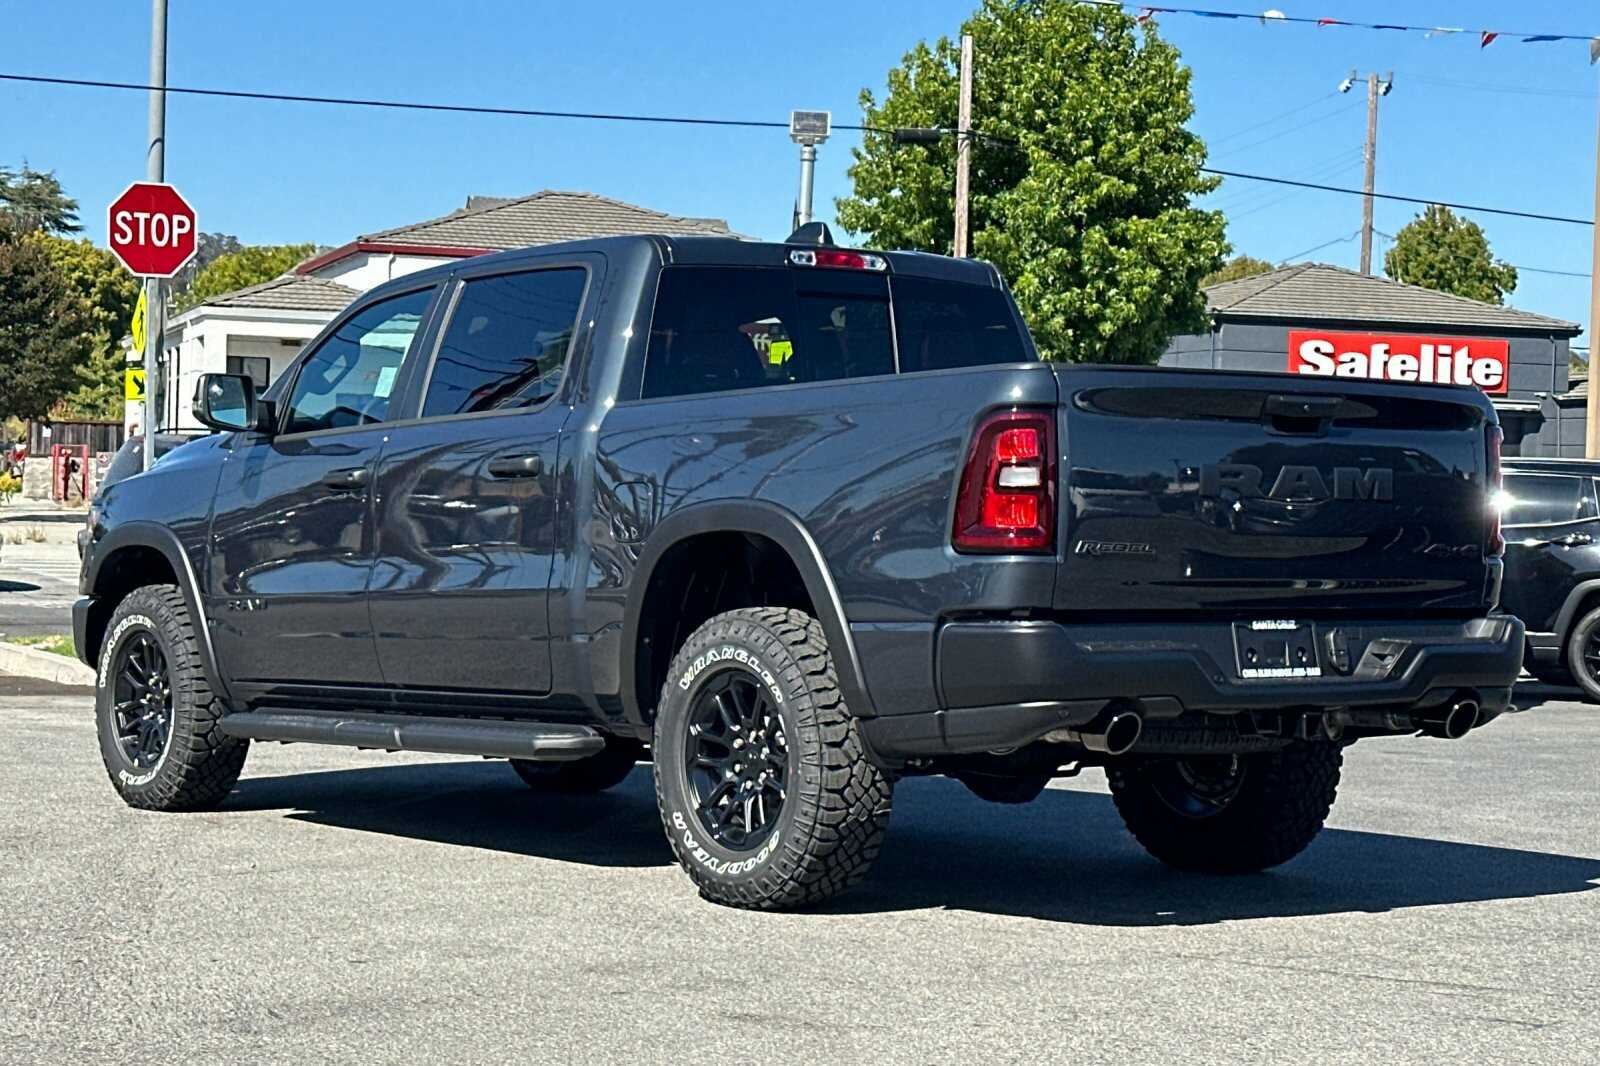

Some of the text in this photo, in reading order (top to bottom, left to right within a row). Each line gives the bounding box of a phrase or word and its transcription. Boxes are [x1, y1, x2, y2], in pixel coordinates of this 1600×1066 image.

[114, 210, 191, 248] STOP
[1298, 339, 1504, 387] Safelite
[1199, 463, 1393, 500] RAM
[1074, 539, 1156, 556] REBEL
[679, 648, 783, 703] WRANGLER
[672, 811, 780, 875] GOODYEAR
